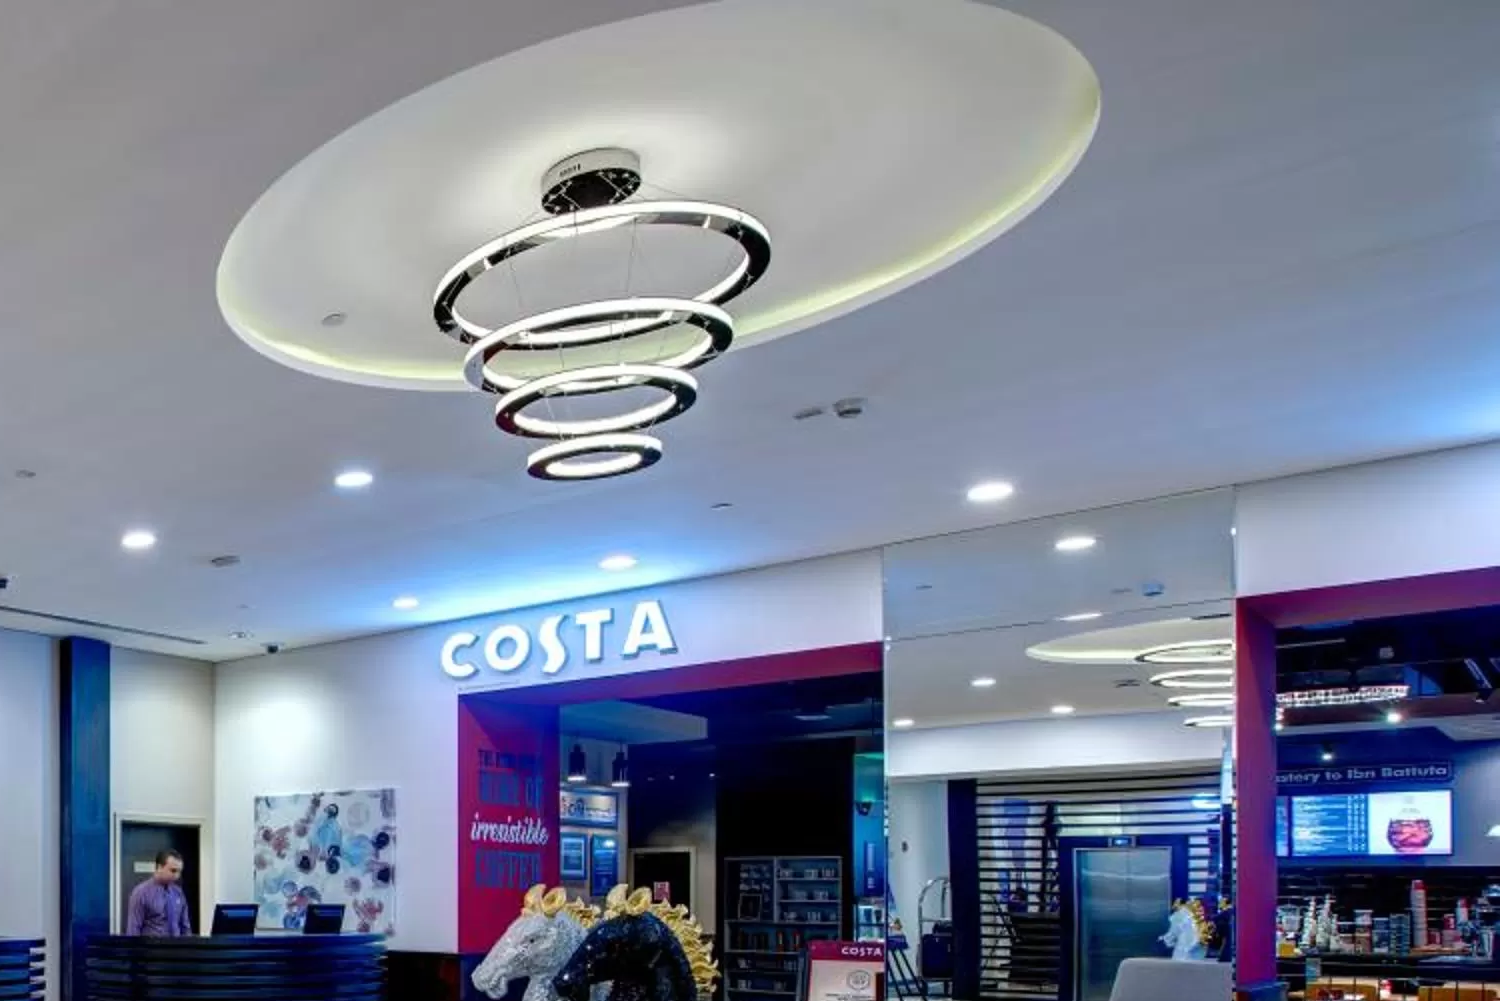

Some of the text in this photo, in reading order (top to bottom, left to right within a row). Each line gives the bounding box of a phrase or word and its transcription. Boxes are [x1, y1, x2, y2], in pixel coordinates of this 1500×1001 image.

[441, 600, 678, 678] COSTA
[1276, 765, 1448, 784] atery to Ibn Battuta
[470, 811, 549, 846] irresistible
[841, 946, 882, 957] COSTA
